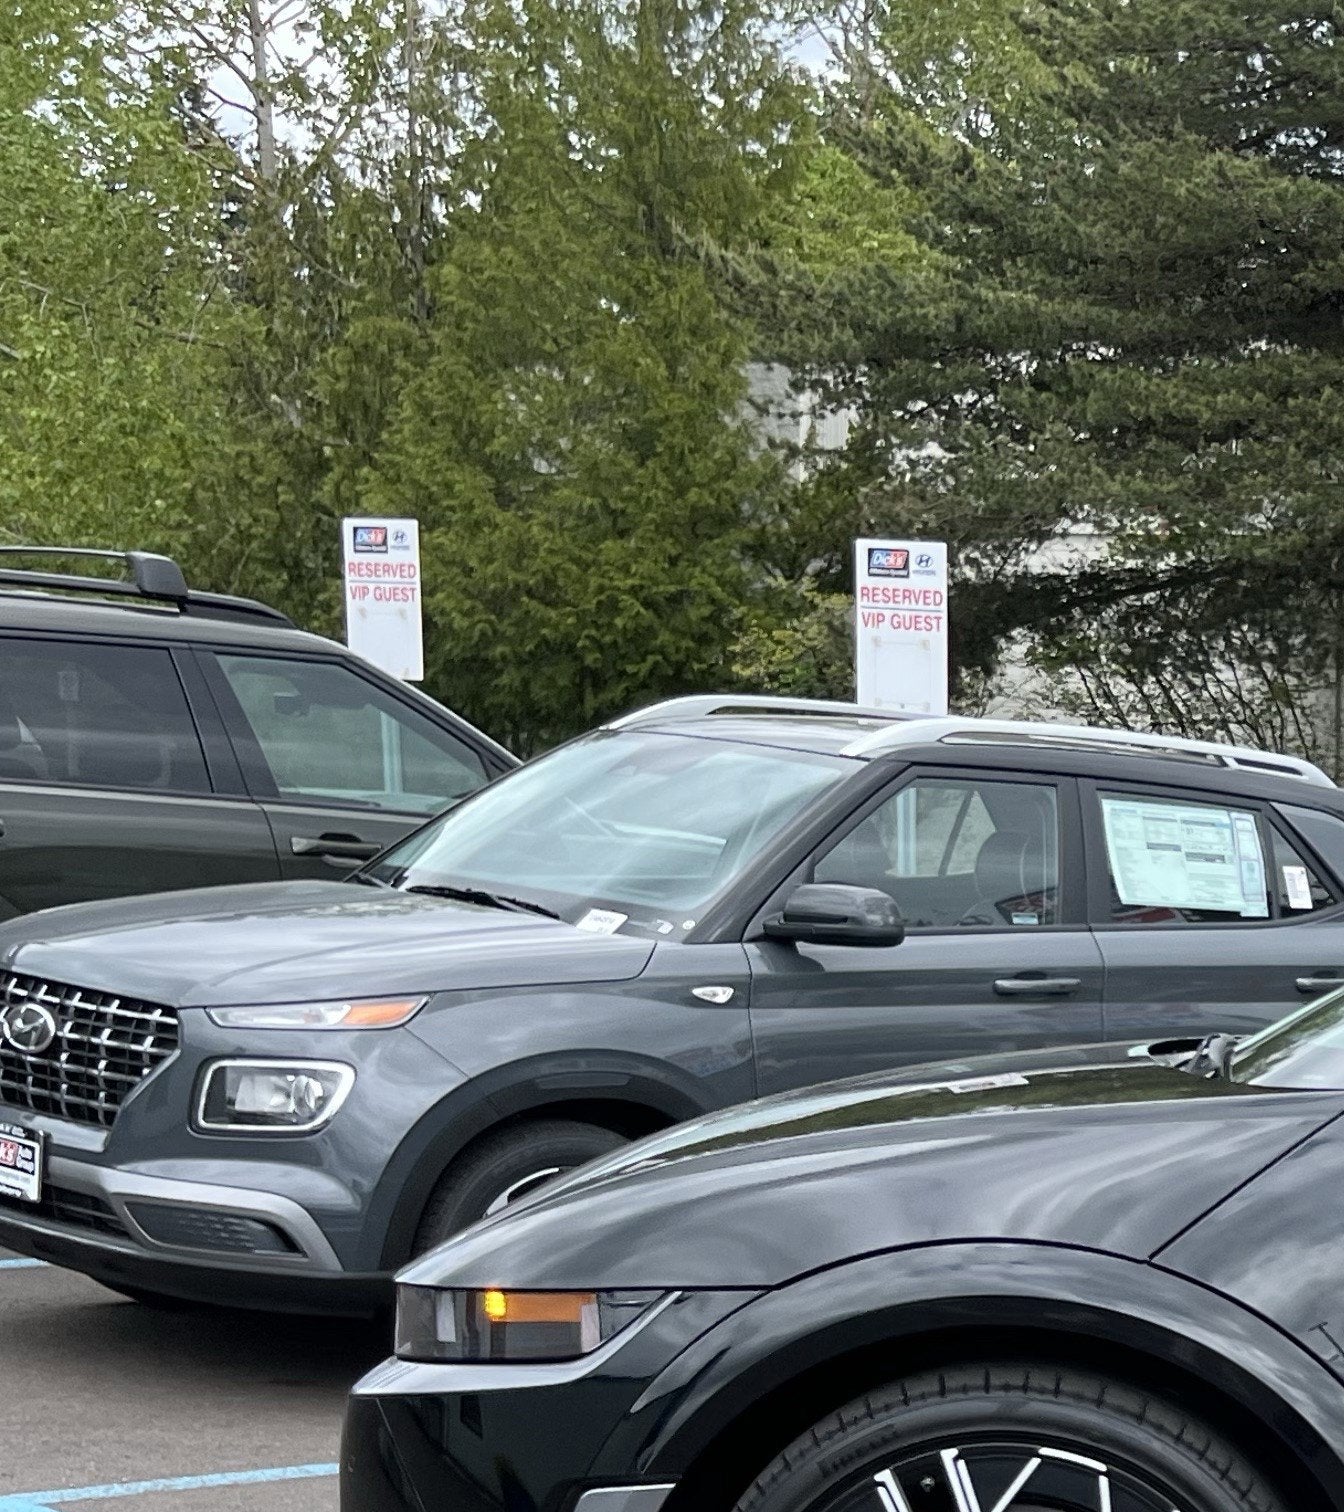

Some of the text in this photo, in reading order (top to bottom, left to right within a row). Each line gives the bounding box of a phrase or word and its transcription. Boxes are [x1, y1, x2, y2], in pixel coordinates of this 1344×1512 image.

[348, 561, 417, 579] RESERVED
[350, 585, 417, 602] VIP GUEST
[860, 586, 943, 606] RESERVED
[861, 612, 942, 631] VIP GUEST
